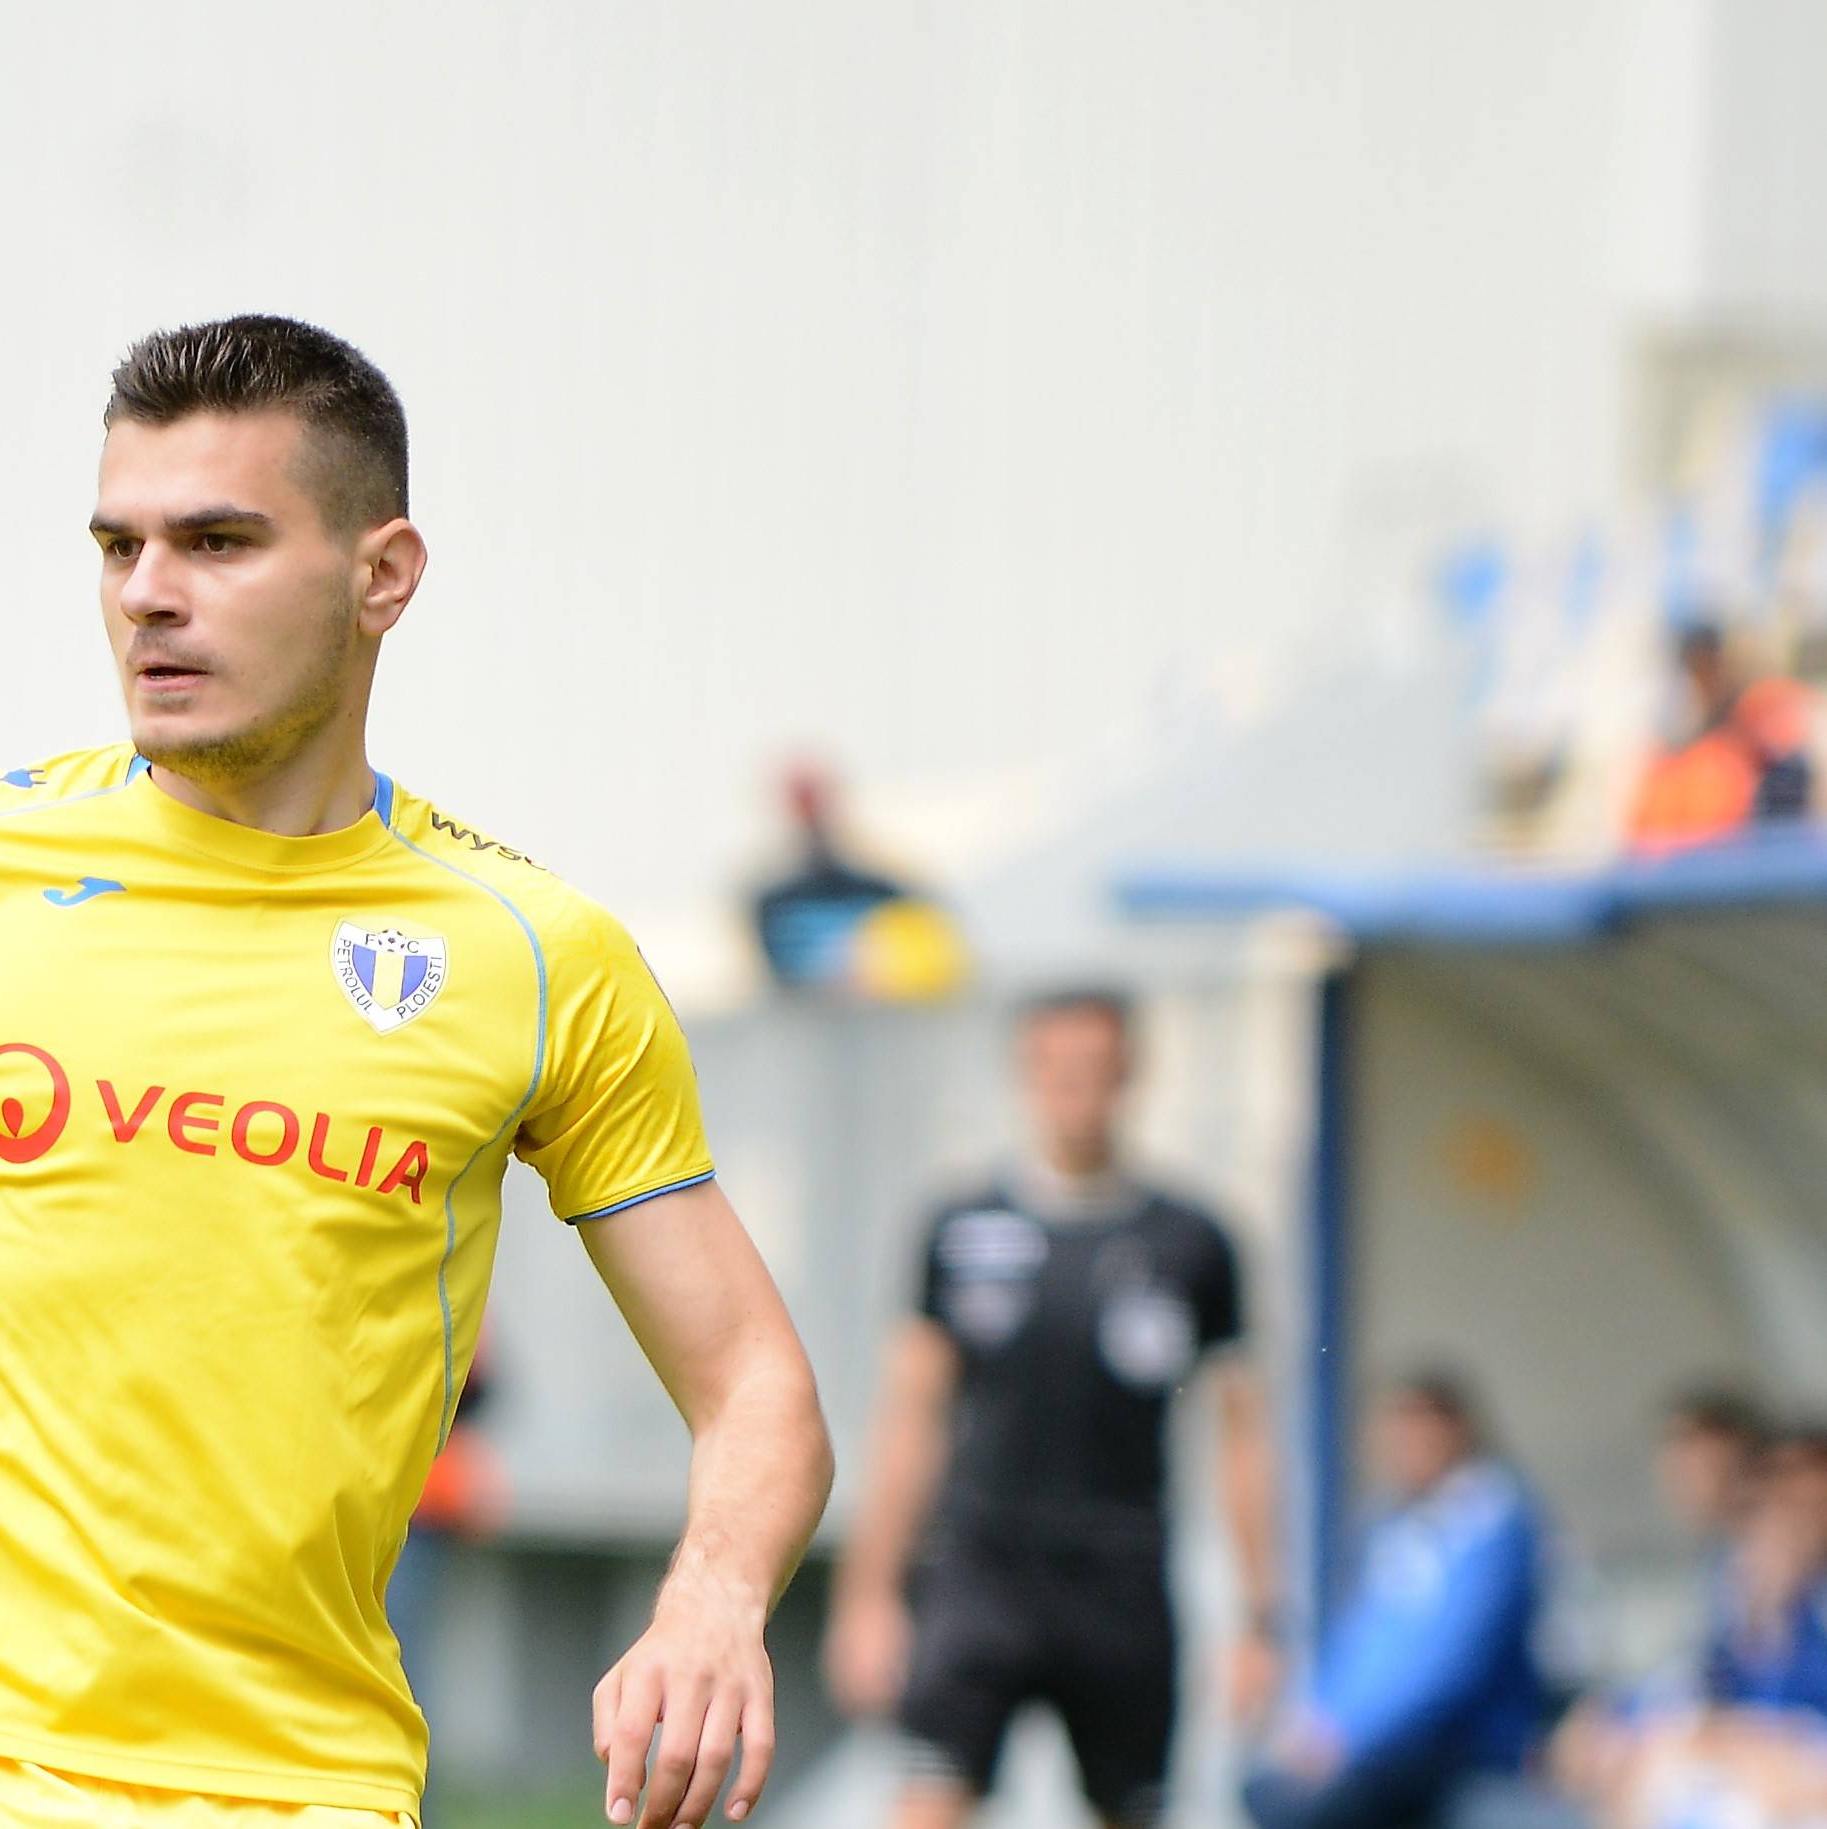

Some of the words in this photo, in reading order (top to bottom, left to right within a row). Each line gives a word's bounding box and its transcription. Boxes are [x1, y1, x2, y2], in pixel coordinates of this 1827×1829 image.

[337, 938, 374, 1015] PETROLUL
[365, 933, 377, 945] F
[407, 940, 420, 954] C
[396, 956, 443, 1020] PLOIESTI
[96, 1079, 429, 1205] VEOLIA
